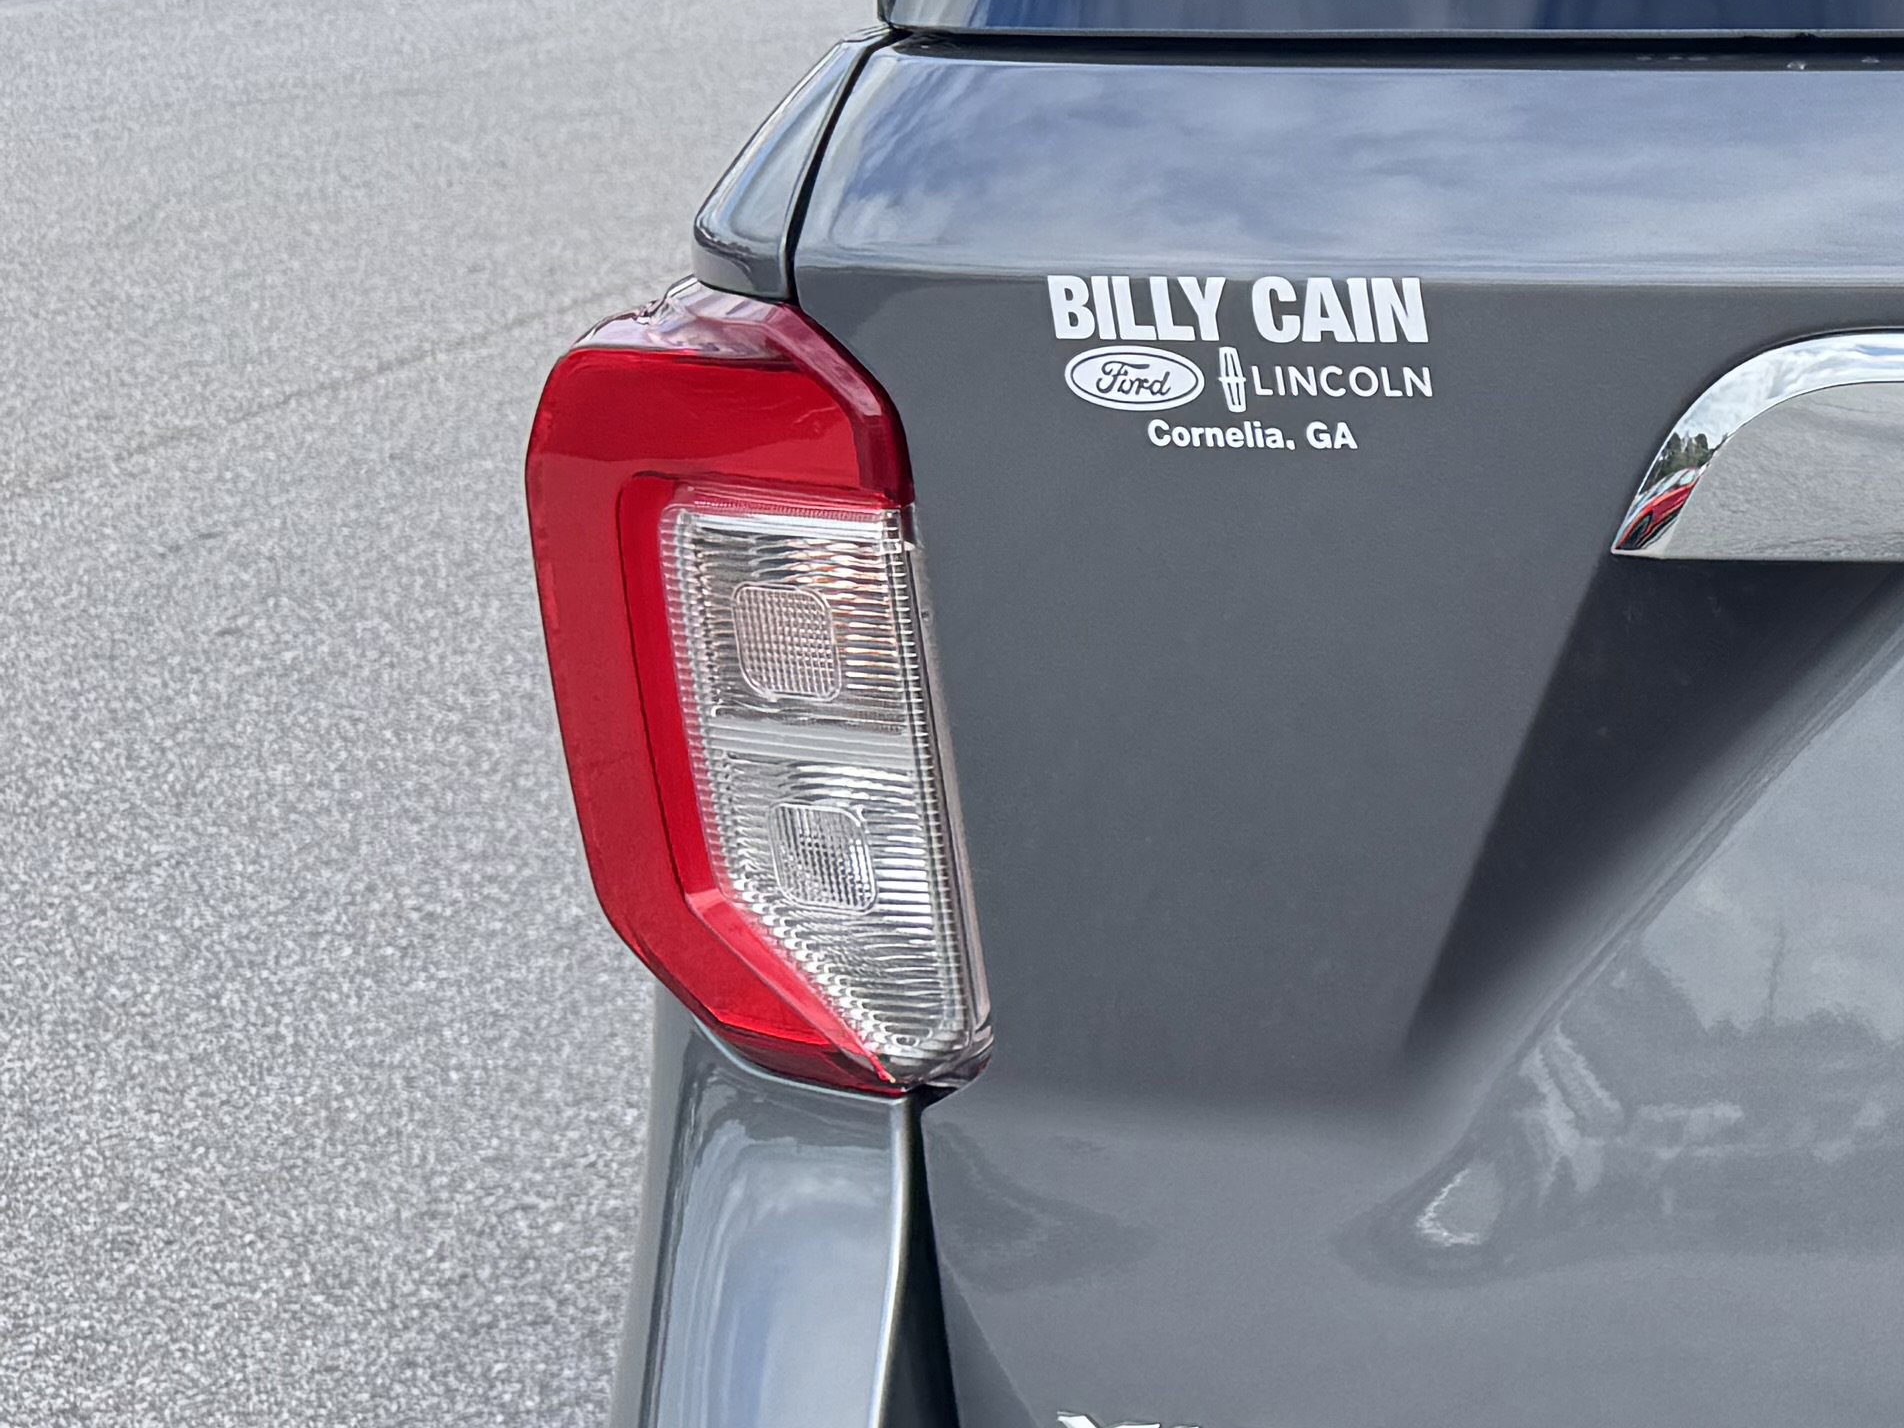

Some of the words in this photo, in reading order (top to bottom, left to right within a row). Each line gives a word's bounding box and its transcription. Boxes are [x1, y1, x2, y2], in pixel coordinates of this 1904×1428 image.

[1046, 275, 1226, 341] BILLY
[1251, 277, 1429, 343] CAIN
[1095, 360, 1172, 397] Ford
[1253, 366, 1433, 398] LINCOLN
[1147, 419, 1296, 450] Cornelia,
[1306, 421, 1358, 450] GA
